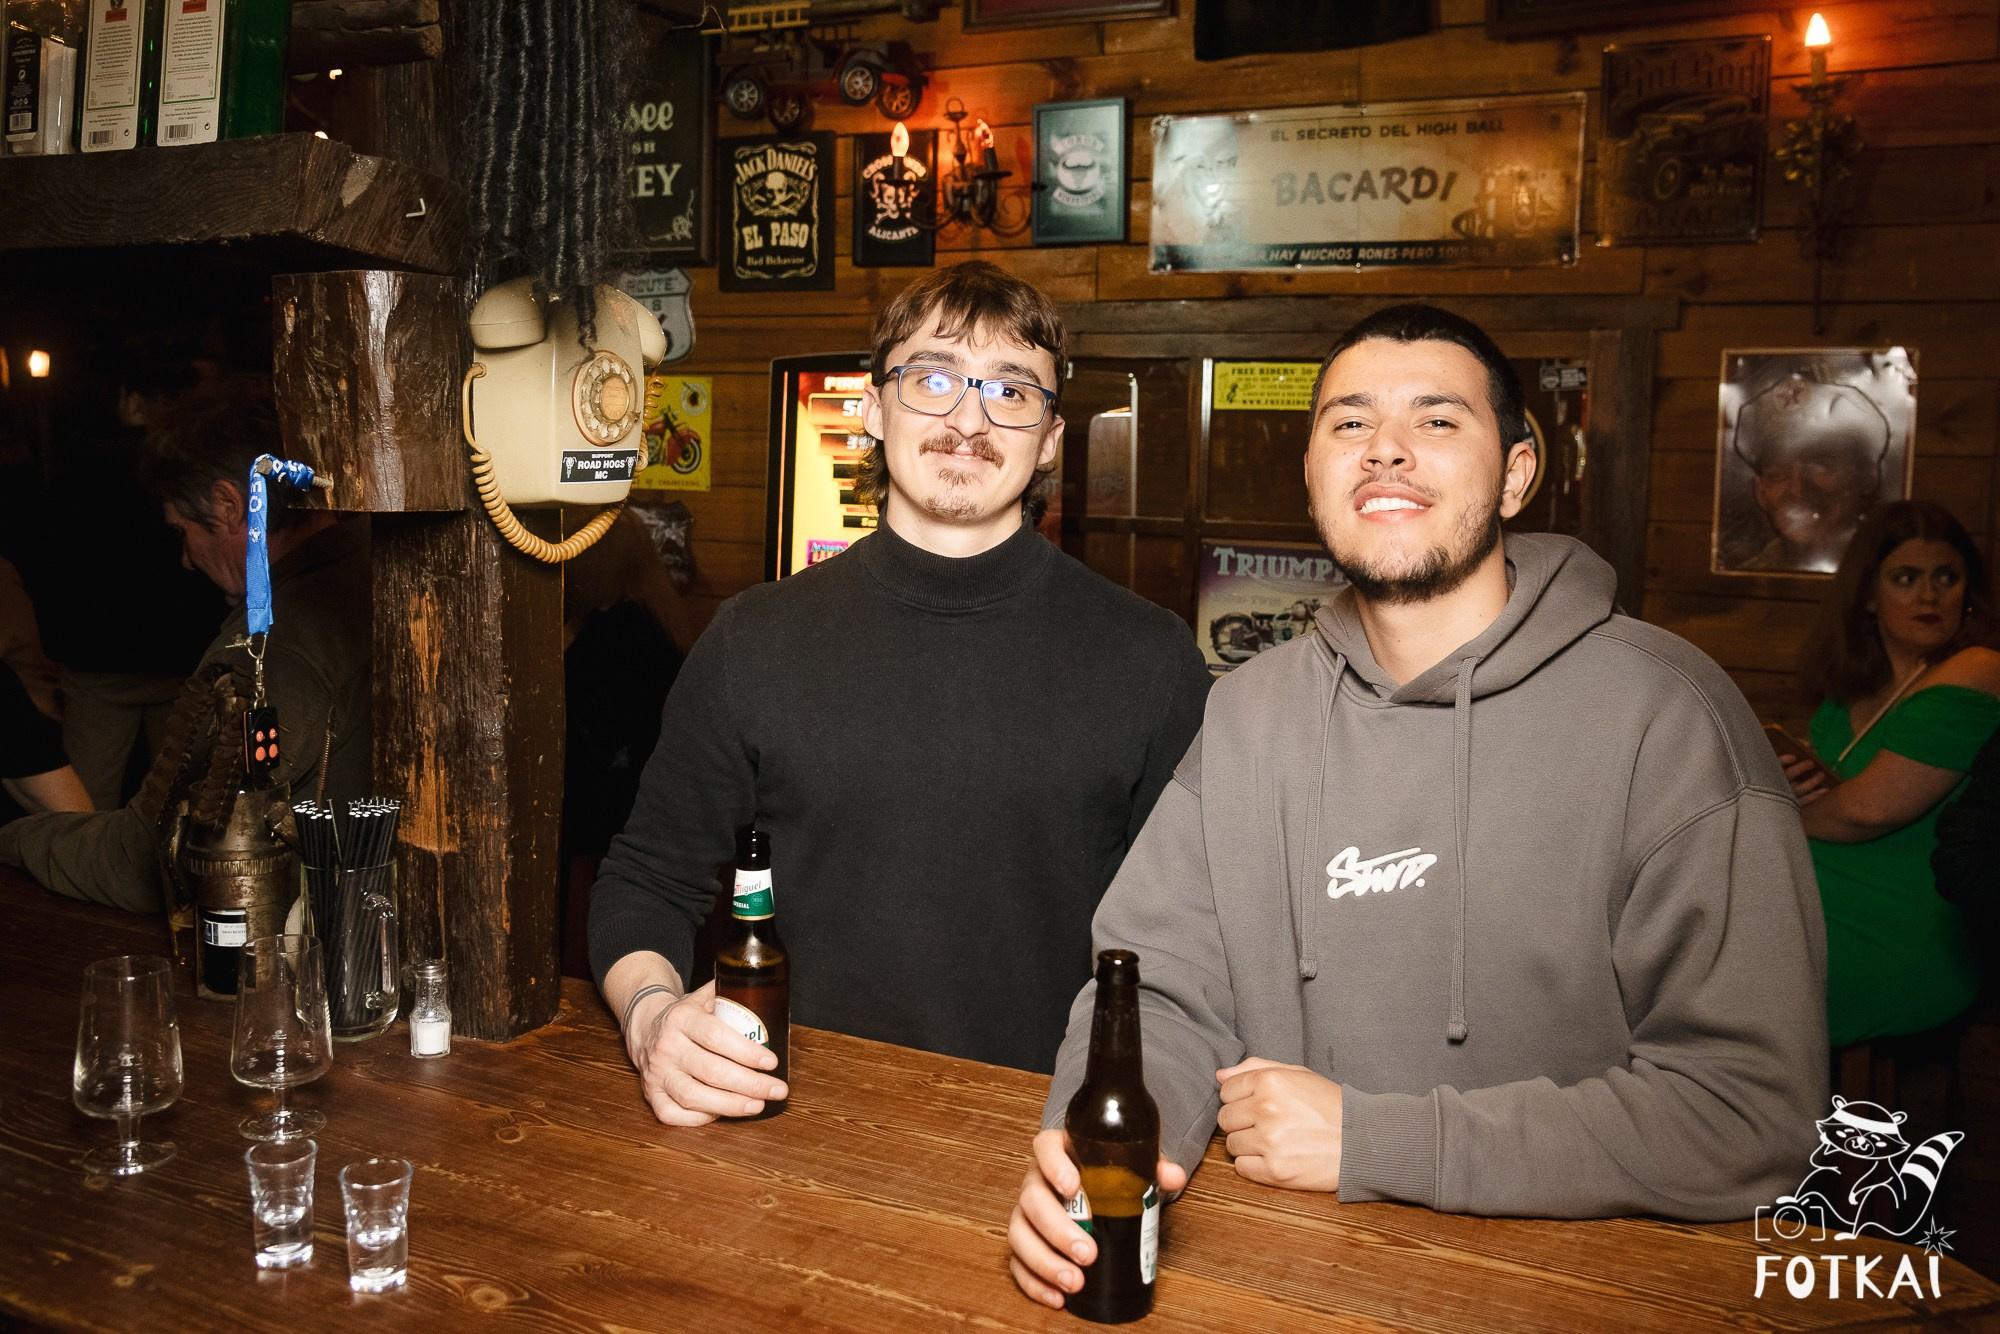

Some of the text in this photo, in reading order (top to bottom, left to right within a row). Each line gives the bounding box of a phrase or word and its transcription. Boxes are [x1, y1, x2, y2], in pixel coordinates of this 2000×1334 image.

[624, 101, 673, 132] see
[1271, 129, 1289, 142] EL
[1296, 126, 1371, 141] SECRETO
[1380, 125, 1410, 138] DEL
[1417, 123, 1457, 136] HIGH
[632, 142, 656, 154] SH
[633, 163, 682, 197] EY
[735, 156, 767, 185] JACK
[1273, 166, 1459, 208] BACARDI
[742, 221, 809, 250] EL PASO
[1269, 250, 1298, 261] HAY
[1300, 248, 1353, 261] MUCHOS
[577, 459, 626, 470] ROAD HOGS
[595, 471, 609, 480] MC
